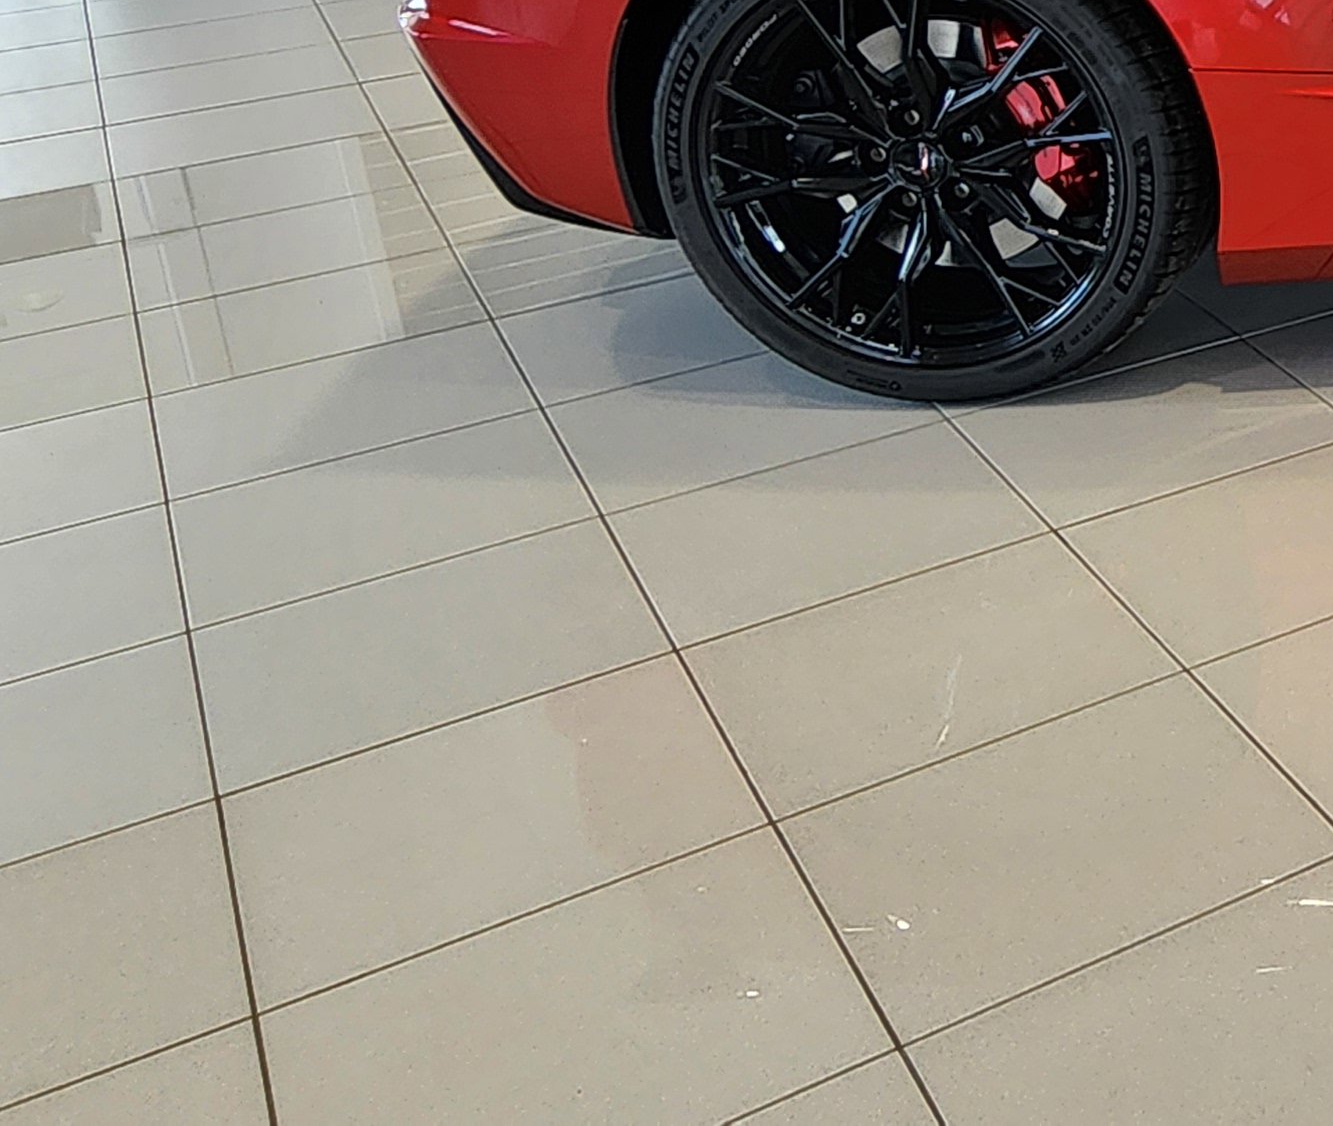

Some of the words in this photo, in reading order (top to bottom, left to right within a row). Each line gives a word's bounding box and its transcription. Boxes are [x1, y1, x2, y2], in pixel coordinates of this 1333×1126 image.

[666, 51, 695, 172] MICHELIN
[1102, 152, 1116, 239] CORVETTE
[1119, 173, 1153, 287] MICHELIN
